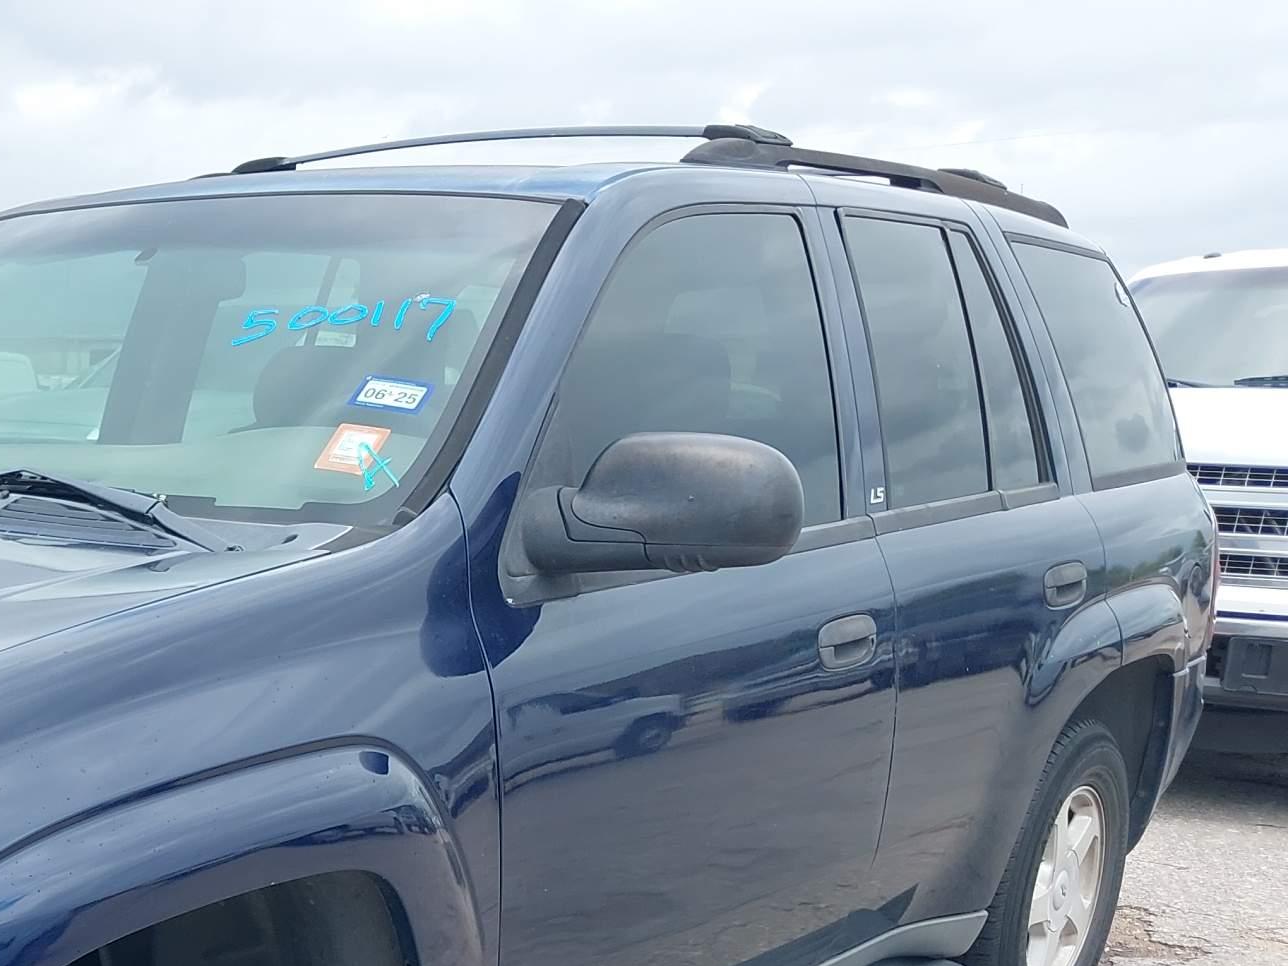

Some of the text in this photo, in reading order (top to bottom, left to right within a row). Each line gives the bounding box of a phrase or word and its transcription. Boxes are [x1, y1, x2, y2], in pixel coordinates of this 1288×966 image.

[231, 298, 456, 346] 500117
[364, 387, 388, 400] 06
[393, 391, 419, 405] 25
[870, 487, 884, 503] LS
